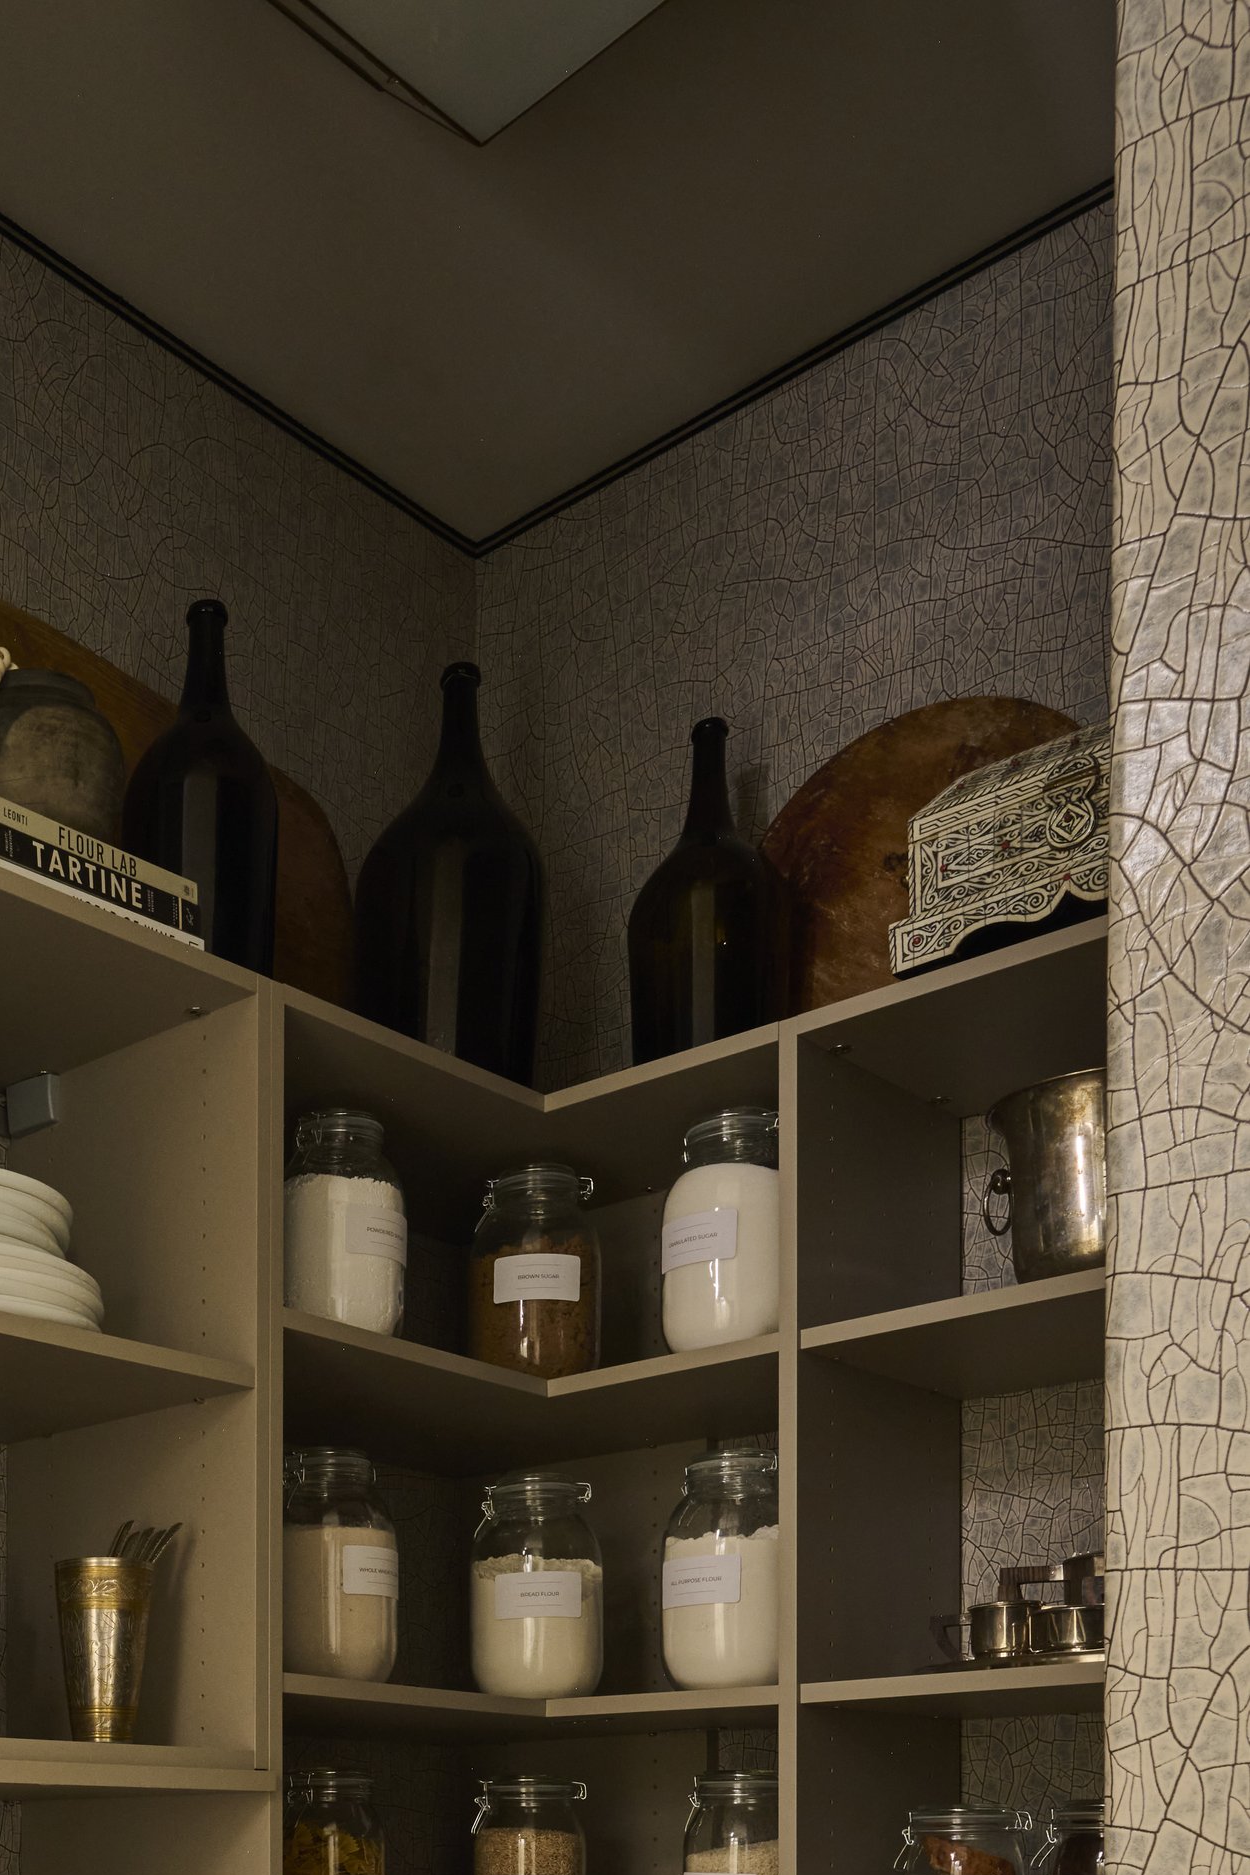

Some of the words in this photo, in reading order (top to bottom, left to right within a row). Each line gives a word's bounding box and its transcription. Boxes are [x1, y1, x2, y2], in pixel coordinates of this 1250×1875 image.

[3, 807, 28, 826] LEONTI
[32, 841, 143, 909] TARTINE
[58, 826, 105, 864] FLOUR
[111, 848, 137, 877] LAB
